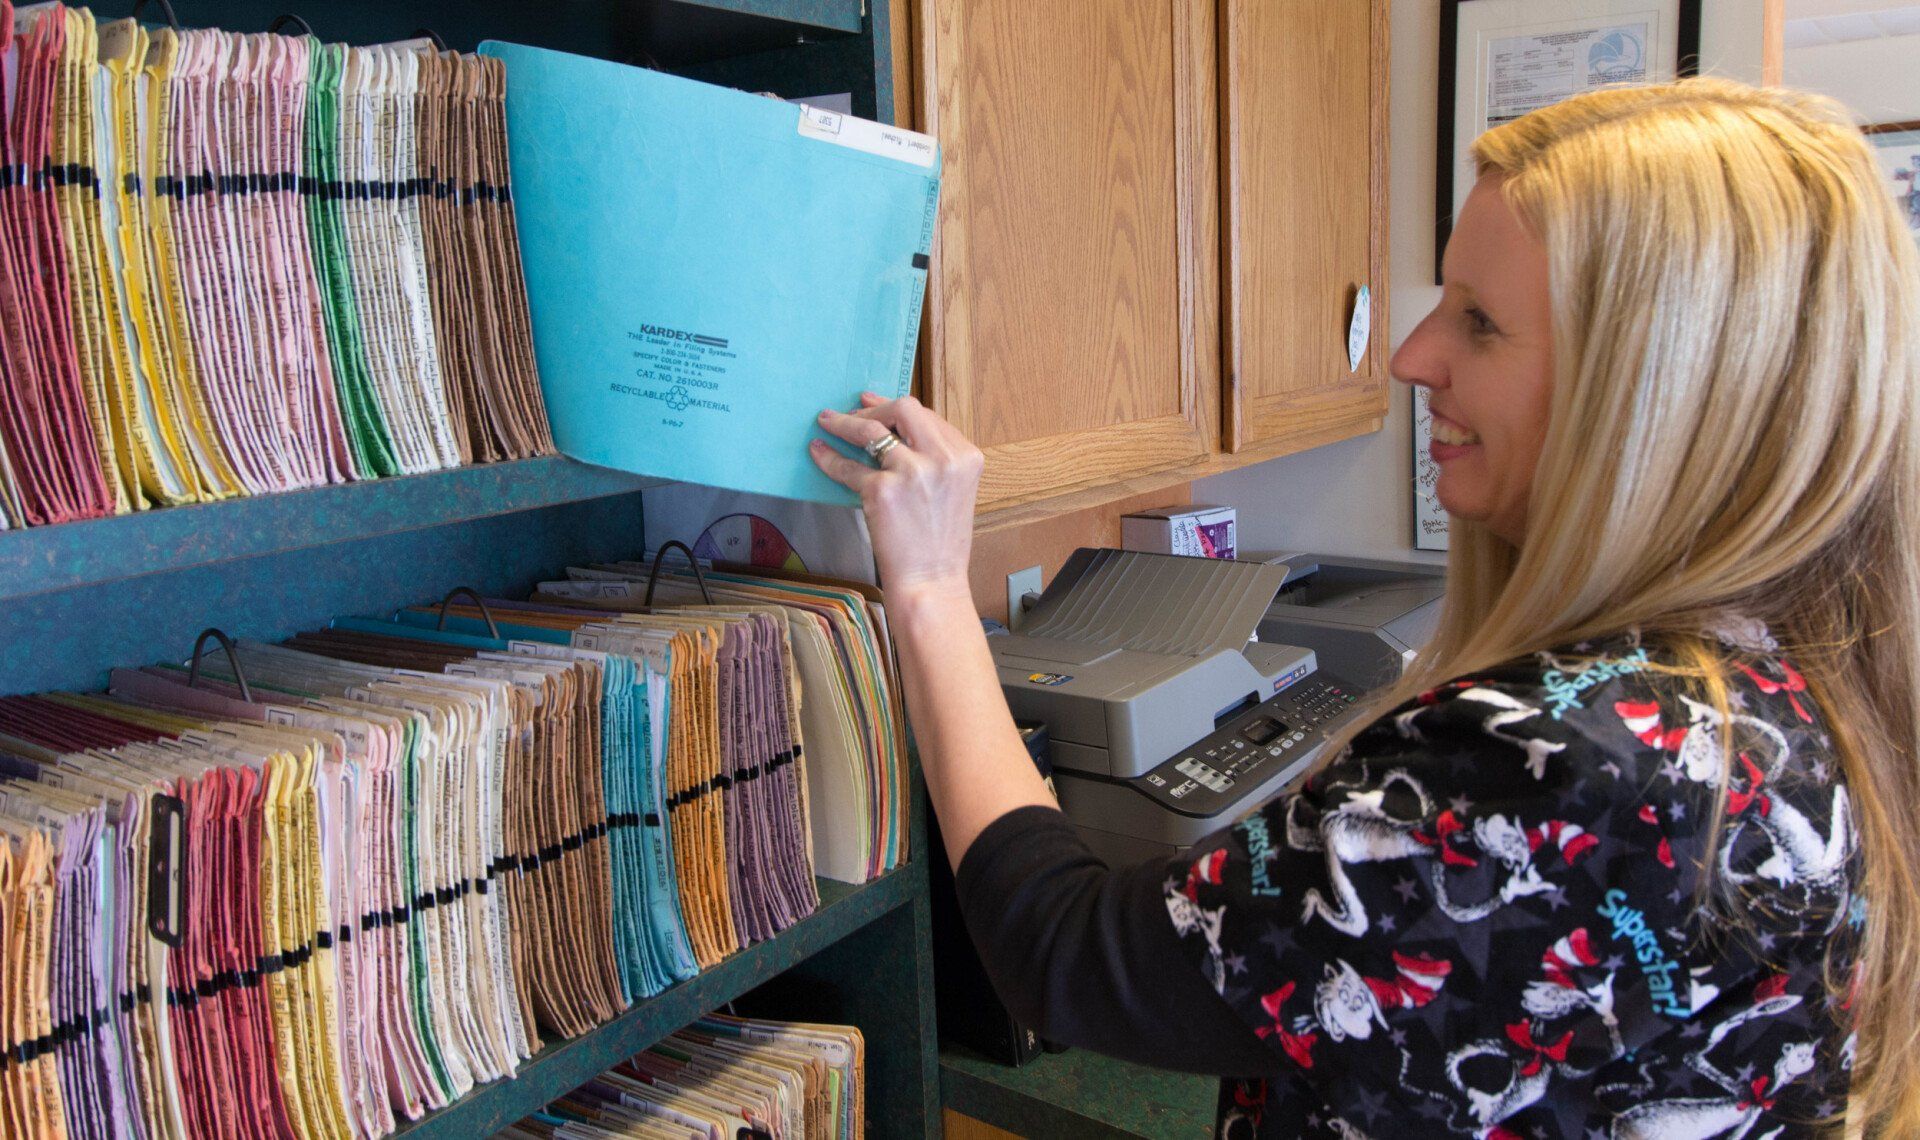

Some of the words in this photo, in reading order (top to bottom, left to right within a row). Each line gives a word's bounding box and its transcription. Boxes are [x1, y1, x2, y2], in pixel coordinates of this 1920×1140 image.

[627, 331, 643, 341] THE
[646, 336, 670, 345] Leader
[708, 347, 737, 358] Systems
[640, 323, 693, 342] KARDEX
[636, 369, 656, 379] CAT.
[676, 376, 719, 390] 2610003R
[610, 383, 665, 400] RECYCLABLE
[689, 398, 730, 412] MATERIAL
[1597, 888, 1691, 1017] Superstar!
